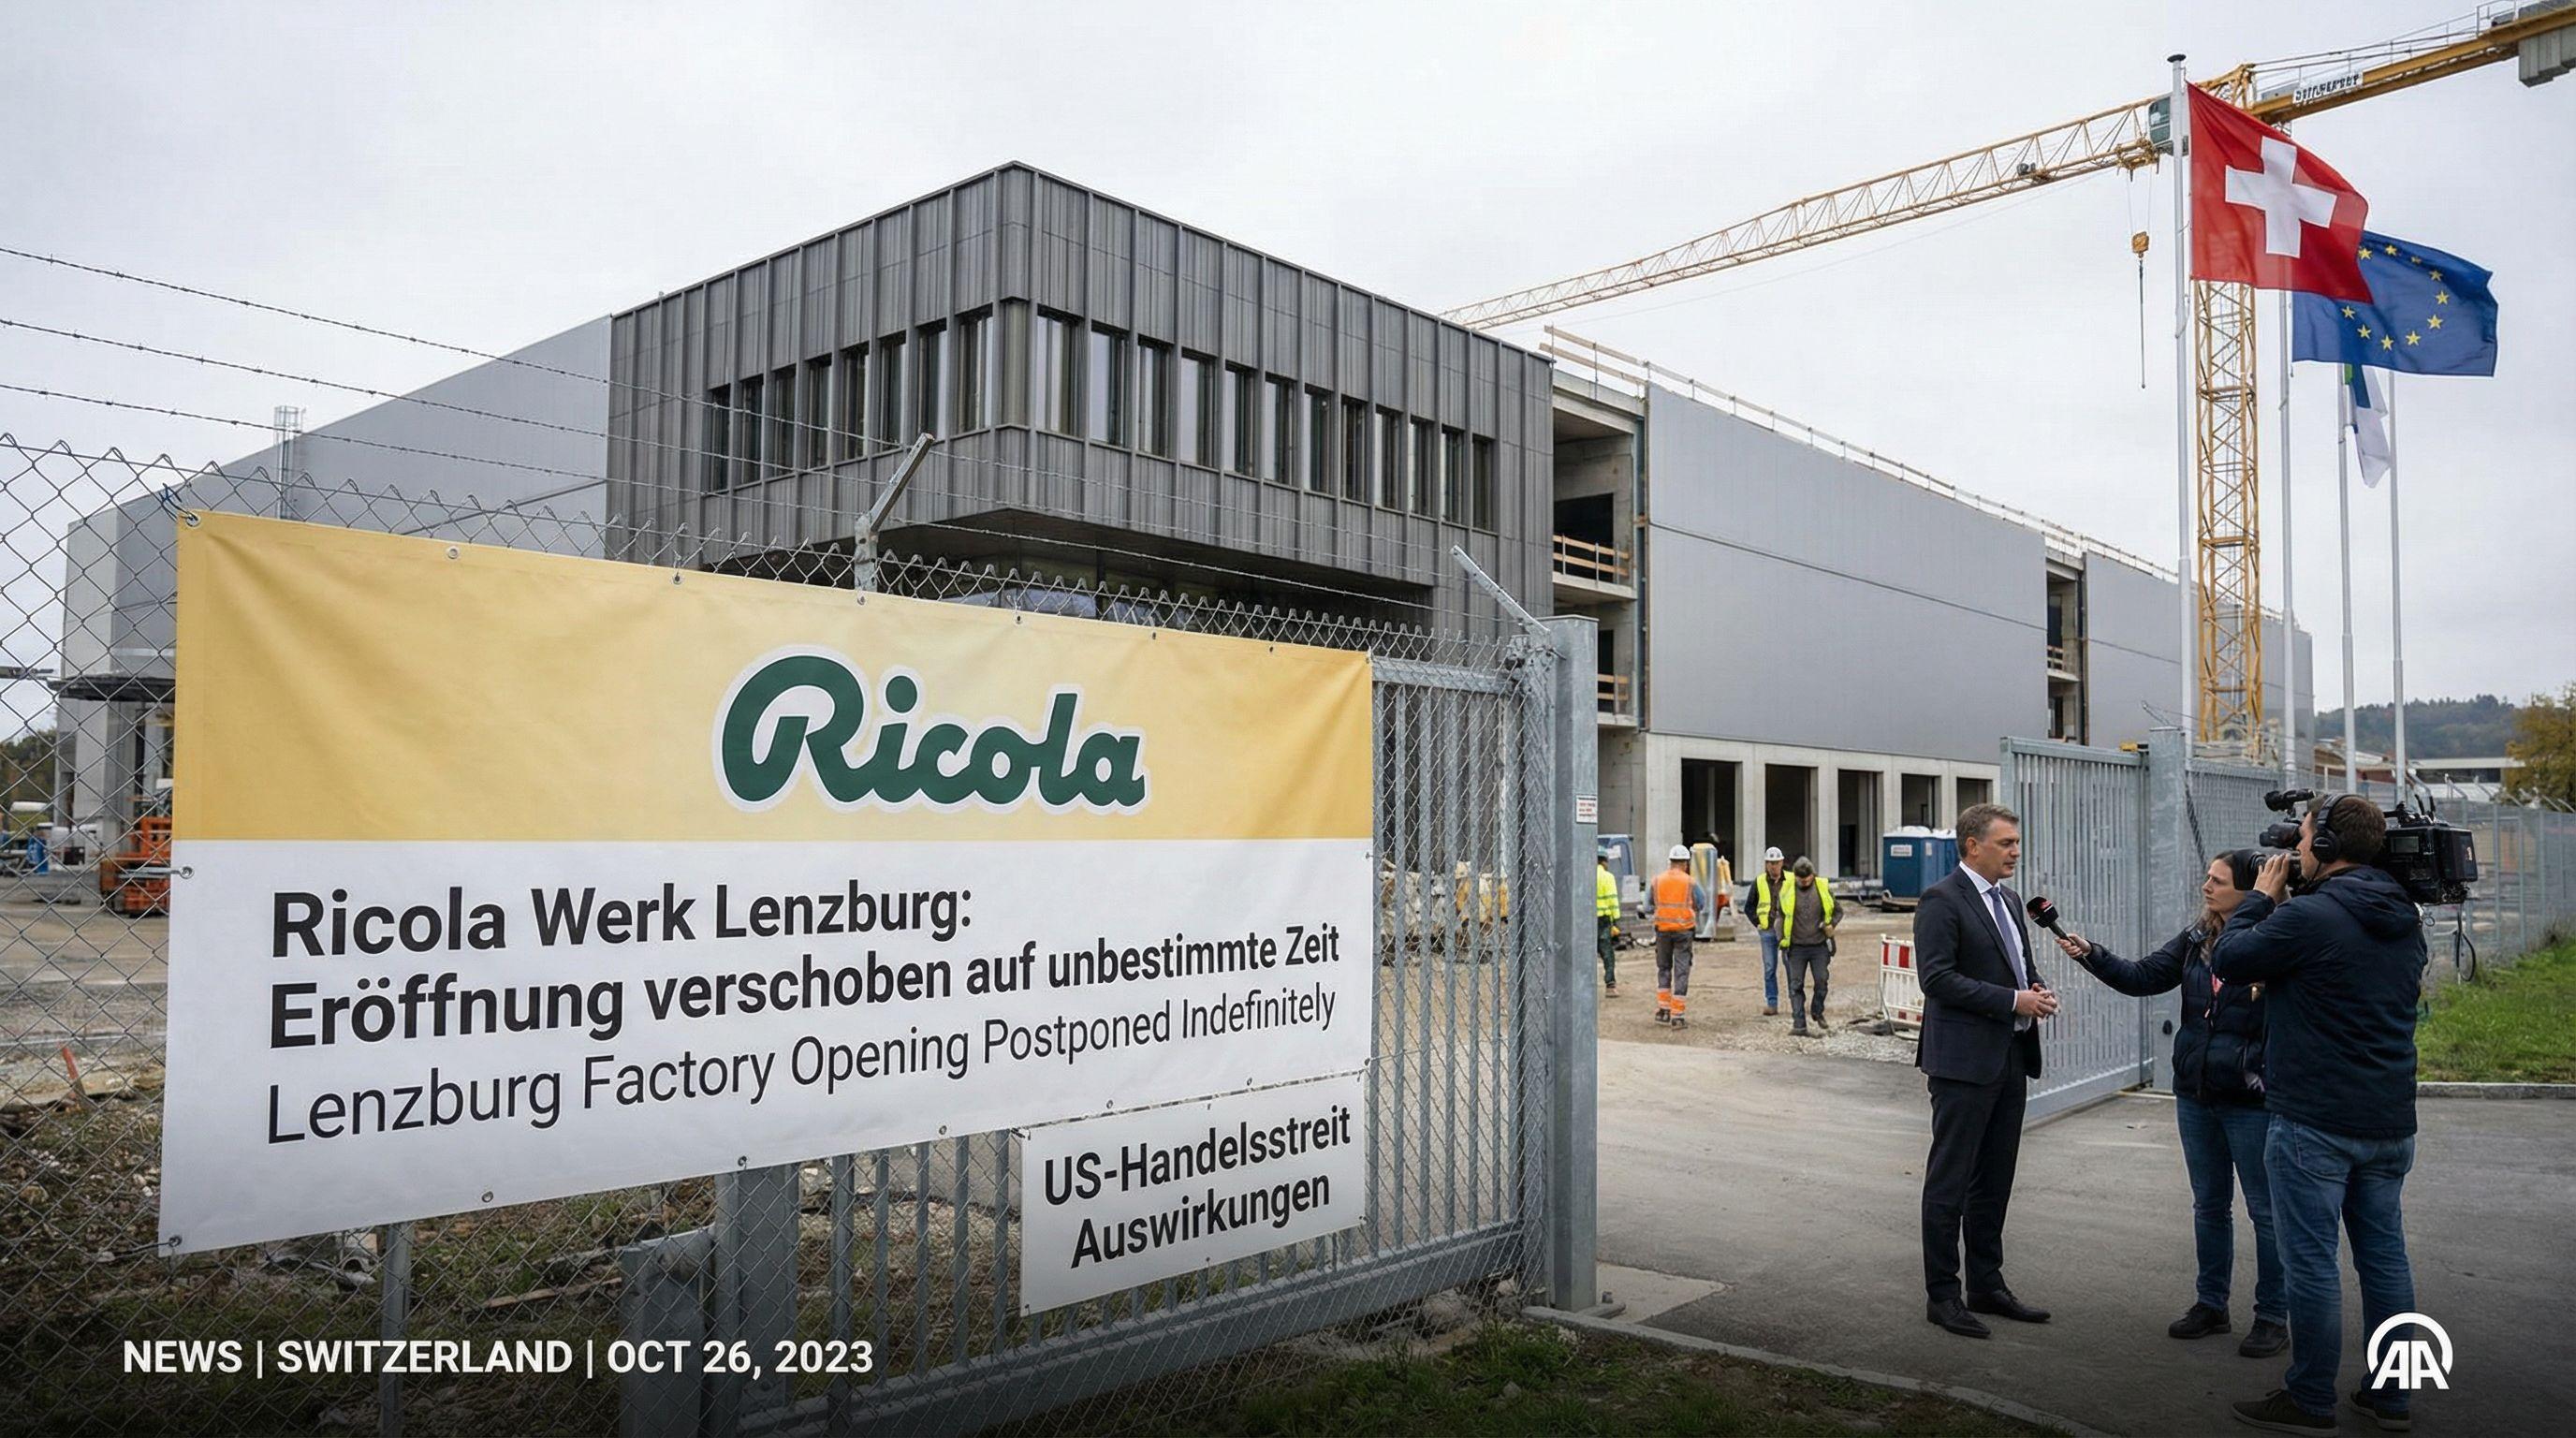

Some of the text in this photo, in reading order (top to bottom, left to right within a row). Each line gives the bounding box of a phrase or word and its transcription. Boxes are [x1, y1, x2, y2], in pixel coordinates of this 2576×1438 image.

[722, 655, 1146, 806] Ricola
[273, 880, 972, 957] Ricola Werk Lenzburg:
[271, 923, 1339, 1049] Eröffnung verschoben auf unbestimmte Zeit
[269, 981, 1336, 1144] Lenzburg Factory Opening Postponed Indefinitely
[1045, 1106, 1351, 1205] US-Handelsstreit
[1070, 1176, 1330, 1269] Auswirkungen
